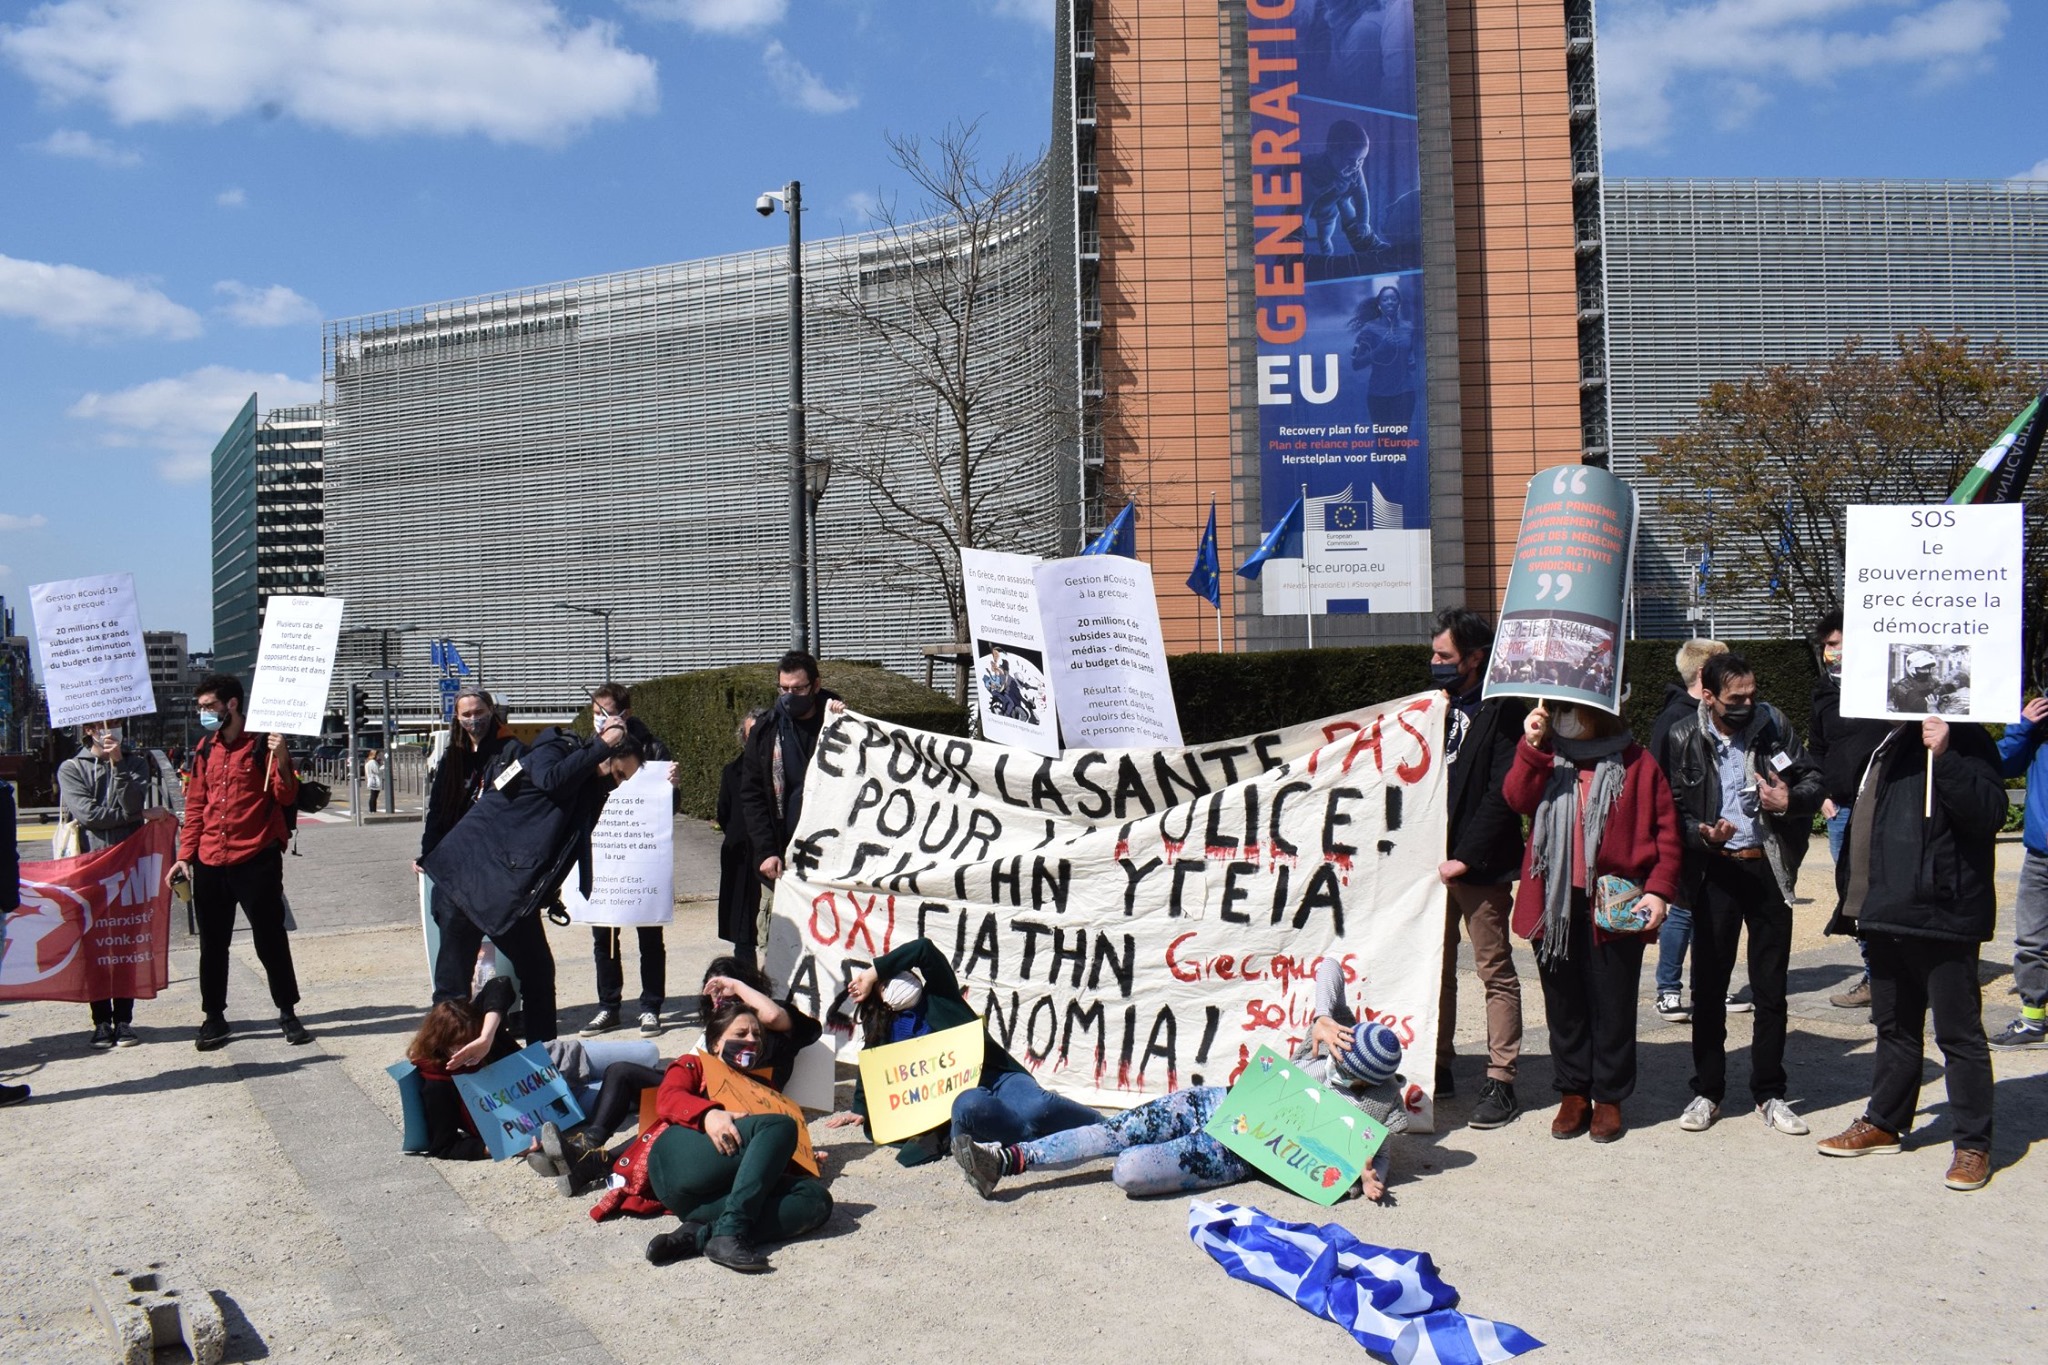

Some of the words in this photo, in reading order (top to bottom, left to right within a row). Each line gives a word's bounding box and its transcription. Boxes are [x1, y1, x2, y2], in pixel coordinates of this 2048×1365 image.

[1257, 353, 1339, 405] EU
[1279, 425, 1326, 436] Recovery
[1328, 424, 1351, 436] plan
[1354, 424, 1369, 434] for
[1372, 423, 1408, 435] Europe
[1269, 440, 1292, 450] Plan
[1295, 439, 1307, 449] de
[1311, 438, 1348, 449] relance
[1351, 440, 1375, 450] pour
[1282, 453, 1341, 465] Herstelplan
[1344, 454, 1367, 463] voor
[1370, 452, 1407, 464] Europa
[1910, 510, 1956, 528] SOS
[1326, 533, 1353, 541] European
[1548, 531, 1568, 541] DES
[1602, 522, 1624, 539] GREC
[1539, 545, 1563, 556] LEUR
[1922, 540, 1944, 555] Le
[1308, 562, 1385, 575] ec.europa.eu
[1528, 560, 1584, 572] SYNDICALE
[968, 568, 977, 577] En
[997, 574, 1006, 582] on
[1064, 575, 1102, 587] Gestion
[1857, 566, 2008, 583] gouvernement
[1282, 581, 1346, 590] #NextGnerationEU
[1351, 580, 1412, 590] #StrongerTogether
[45, 592, 77, 604] Gestion
[78, 586, 118, 598] #Covid-19
[986, 586, 1018, 598] journaliste
[1019, 591, 1030, 600] qui
[1087, 589, 1096, 598] la
[1098, 590, 1129, 599] grecque
[1862, 593, 1906, 610] grec
[1911, 590, 1977, 608] écrase
[1984, 591, 2001, 608] la
[63, 604, 72, 612] la
[73, 600, 105, 612] grecque
[980, 598, 1005, 609] enquête
[1017, 604, 1029, 613] des
[276, 620, 301, 629] Plusieurs
[314, 621, 324, 630] de
[991, 613, 1021, 625] scandales
[1077, 618, 1090, 628] 20
[1092, 616, 1126, 626] millions
[1132, 620, 1140, 630] de
[1872, 617, 1990, 635] démocratie
[56, 627, 67, 636] 20
[67, 622, 100, 634] millions
[108, 619, 119, 628] de
[980, 625, 1035, 641] gouvernementaux
[49, 636, 84, 648] subsides
[85, 634, 100, 642] aux
[102, 629, 130, 641] grands
[281, 631, 302, 639] torture
[1069, 631, 1111, 643] subsides
[1128, 634, 1148, 646] grands
[51, 647, 80, 659] médias
[86, 641, 132, 653] diminution
[1071, 645, 1107, 656] médias
[1114, 644, 1150, 659] diminution
[49, 662, 60, 670] du
[62, 657, 91, 668] budget
[92, 655, 103, 663] de
[104, 653, 112, 661] la
[113, 650, 137, 660] santé
[298, 654, 314, 662] dans
[1070, 661, 1083, 670] du
[1085, 658, 1119, 668] budget
[1120, 658, 1130, 667] de
[1131, 659, 1138, 669] la
[309, 667, 326, 675] dans
[60, 678, 92, 691] Résultat
[99, 676, 113, 685] des
[114, 674, 133, 684] gens
[64, 690, 99, 702] meurent
[100, 686, 120, 696] dans
[121, 684, 133, 692] les
[1083, 685, 1122, 696] Résultat
[1128, 686, 1139, 696] des
[1140, 690, 1155, 701] gens
[58, 703, 90, 714] couloirs
[91, 699, 106, 708] des
[106, 695, 143, 706] hôpitaux
[1088, 698, 1128, 709] meurent
[1130, 699, 1145, 710] dans
[1145, 702, 1155, 713] les
[68, 711, 105, 724] personne
[126, 705, 147, 715] parle
[1081, 711, 1119, 723] couloirs
[1120, 711, 1135, 721] des
[1081, 728, 1091, 736] et
[1092, 726, 1135, 737] personne
[1152, 731, 1169, 743] parle
[856, 721, 980, 798] POUR
[1307, 699, 1434, 785] PAS
[634, 797, 645, 805] de
[625, 808, 635, 816] de
[848, 777, 1002, 860] POUR
[623, 831, 642, 839] dans
[643, 831, 655, 839] les
[638, 842, 657, 850] dans
[610, 886, 641, 896] policiers
[590, 898, 606, 907] peut
[610, 898, 636, 906] tolérer
[1250, 1121, 1326, 1182] NATURE
